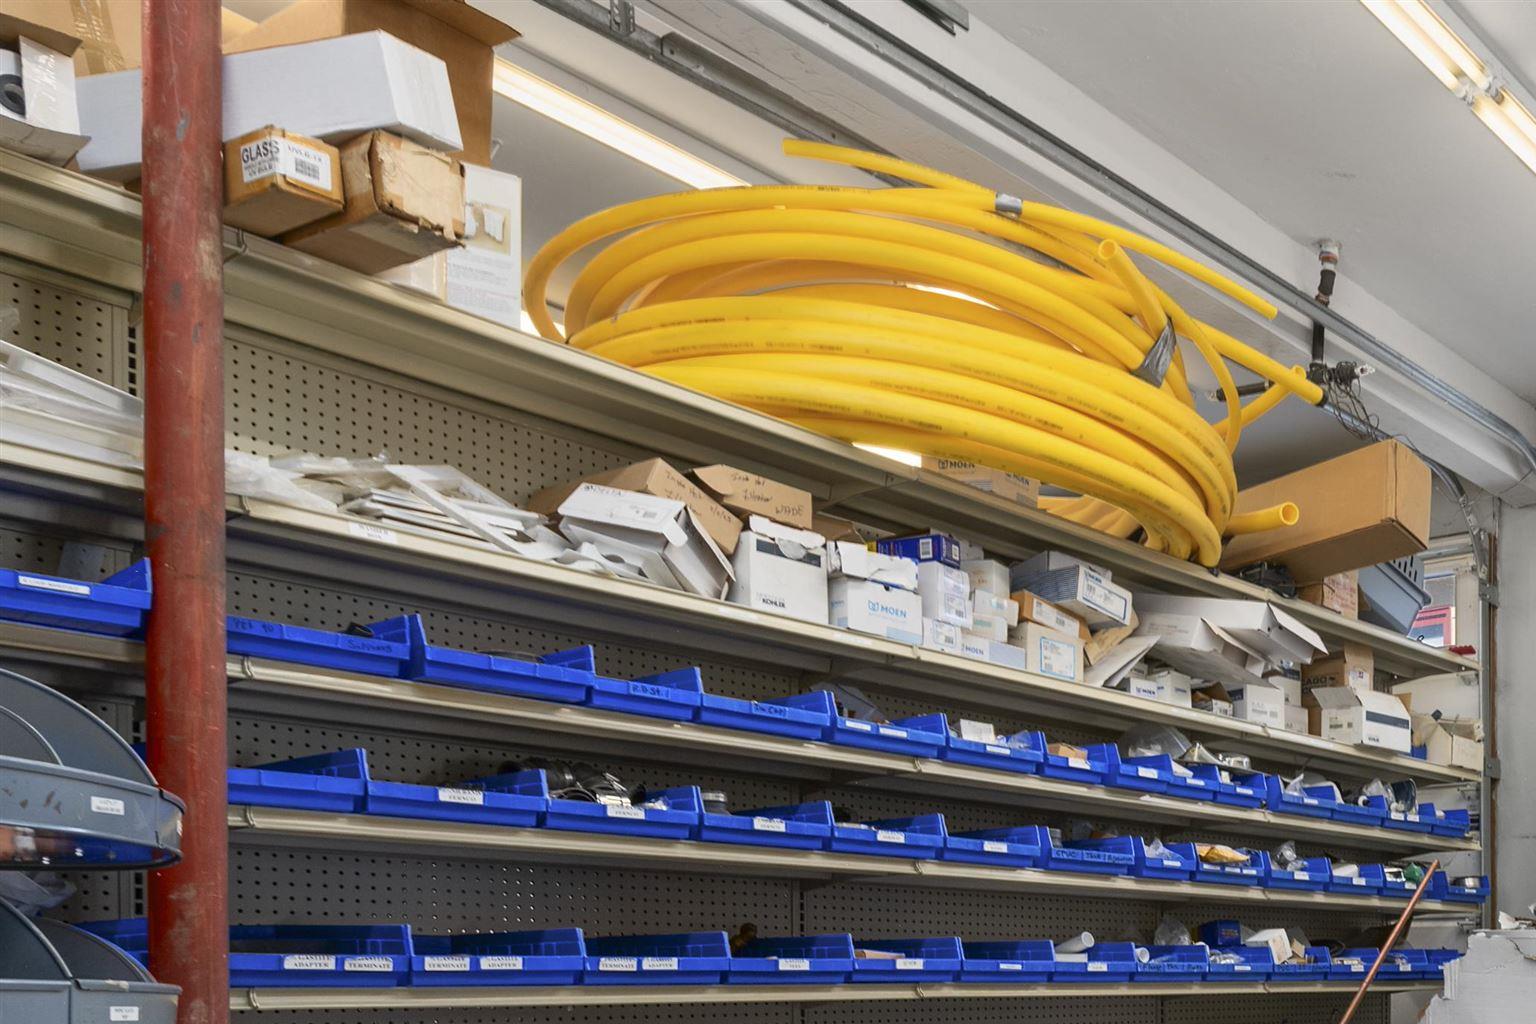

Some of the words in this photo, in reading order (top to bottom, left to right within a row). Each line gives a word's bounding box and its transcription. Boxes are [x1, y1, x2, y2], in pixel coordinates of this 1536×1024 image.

[242, 139, 280, 164] GLASS
[949, 460, 975, 469] MOEN
[881, 604, 907, 619] MOEN
[965, 645, 985, 656] MOEN
[348, 962, 391, 970] TERMINATE
